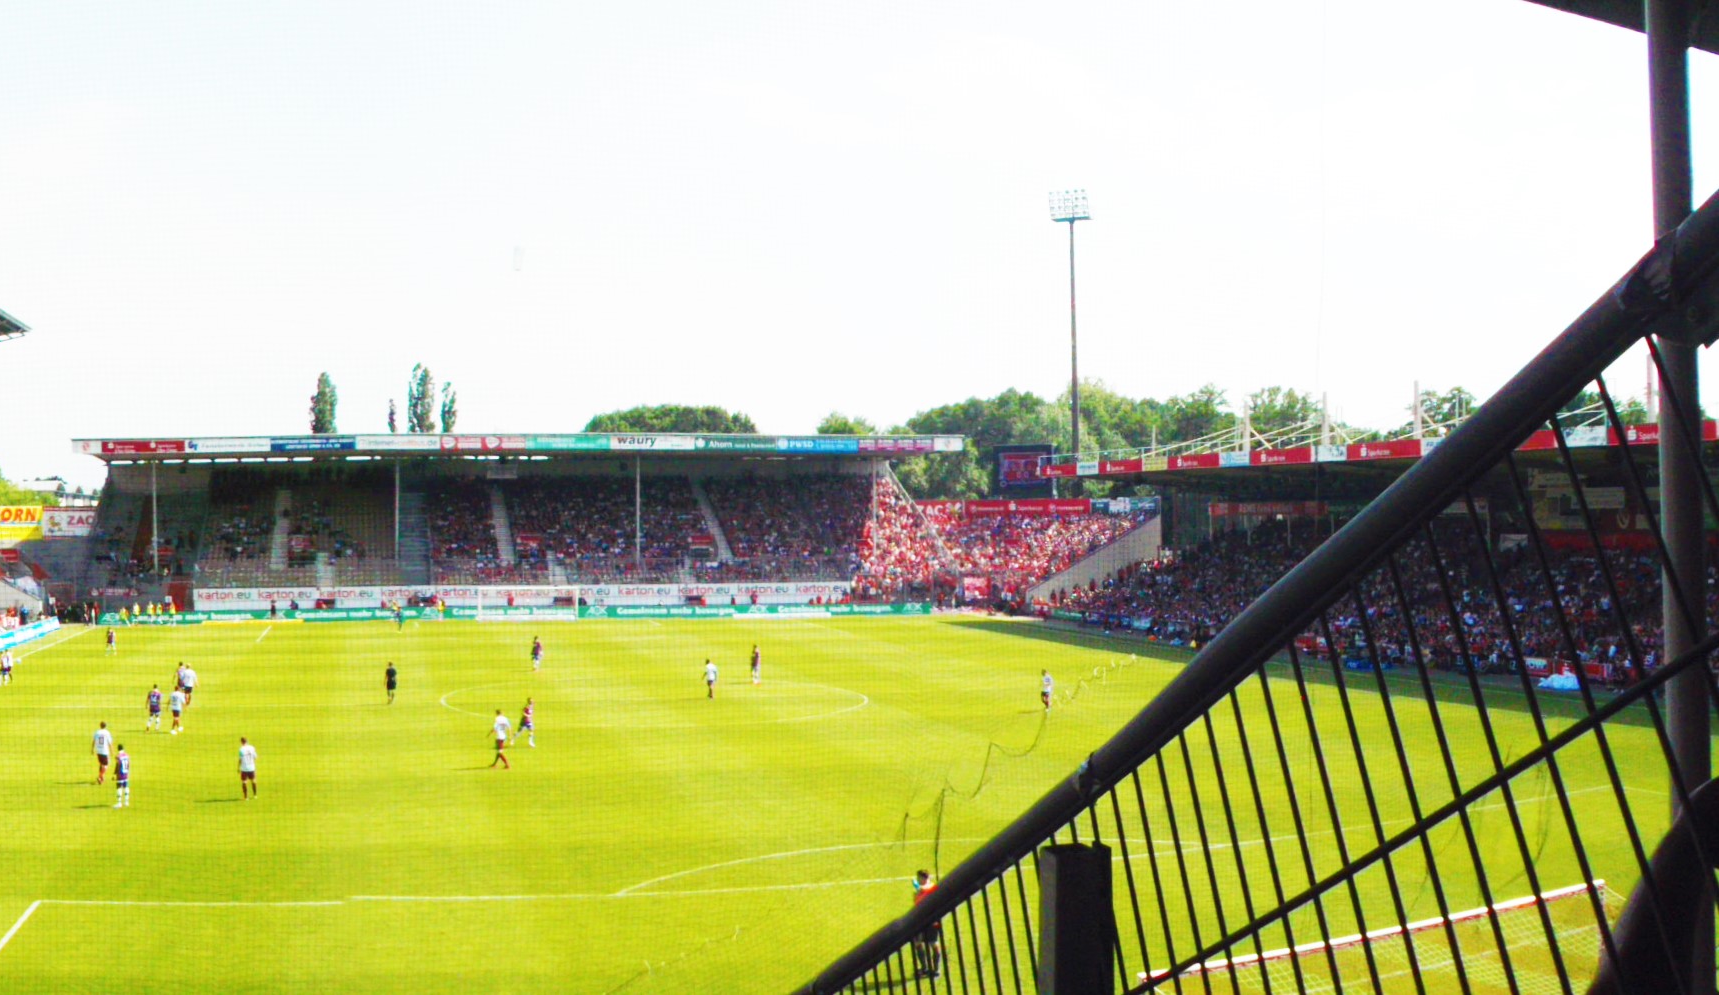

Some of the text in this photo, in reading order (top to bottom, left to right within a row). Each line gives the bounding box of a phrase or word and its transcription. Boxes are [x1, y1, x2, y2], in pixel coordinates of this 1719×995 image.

[197, 589, 251, 600] karton.eu
[258, 589, 312, 600] karton.eu
[318, 588, 373, 599] karton.eu
[618, 585, 670, 597] karton.eu
[617, 607, 668, 616] Gemeinsam
[670, 607, 692, 616] mehr
